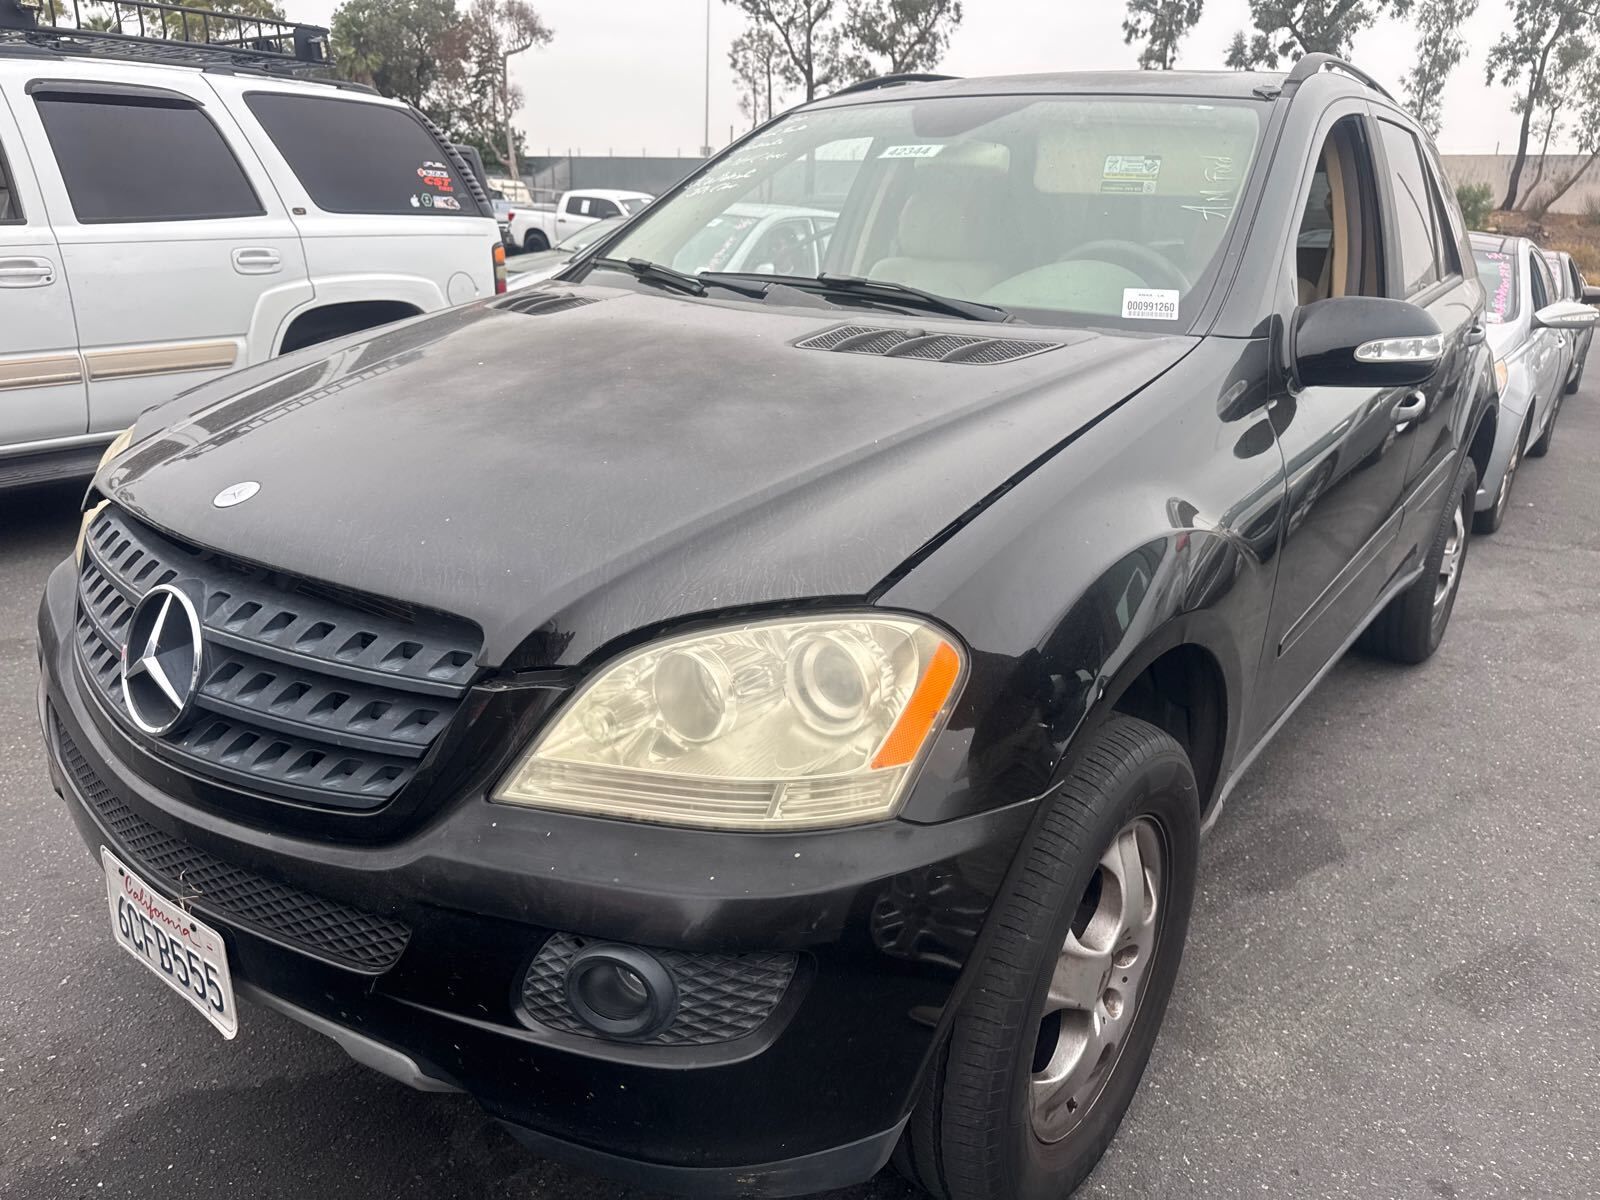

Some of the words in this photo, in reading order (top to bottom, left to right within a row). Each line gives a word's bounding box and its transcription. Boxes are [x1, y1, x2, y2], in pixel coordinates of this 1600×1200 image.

[886, 146, 933, 156] 42344
[1127, 301, 1175, 312] 000991260
[124, 875, 202, 948] California
[118, 895, 224, 1013] 6CFB555
